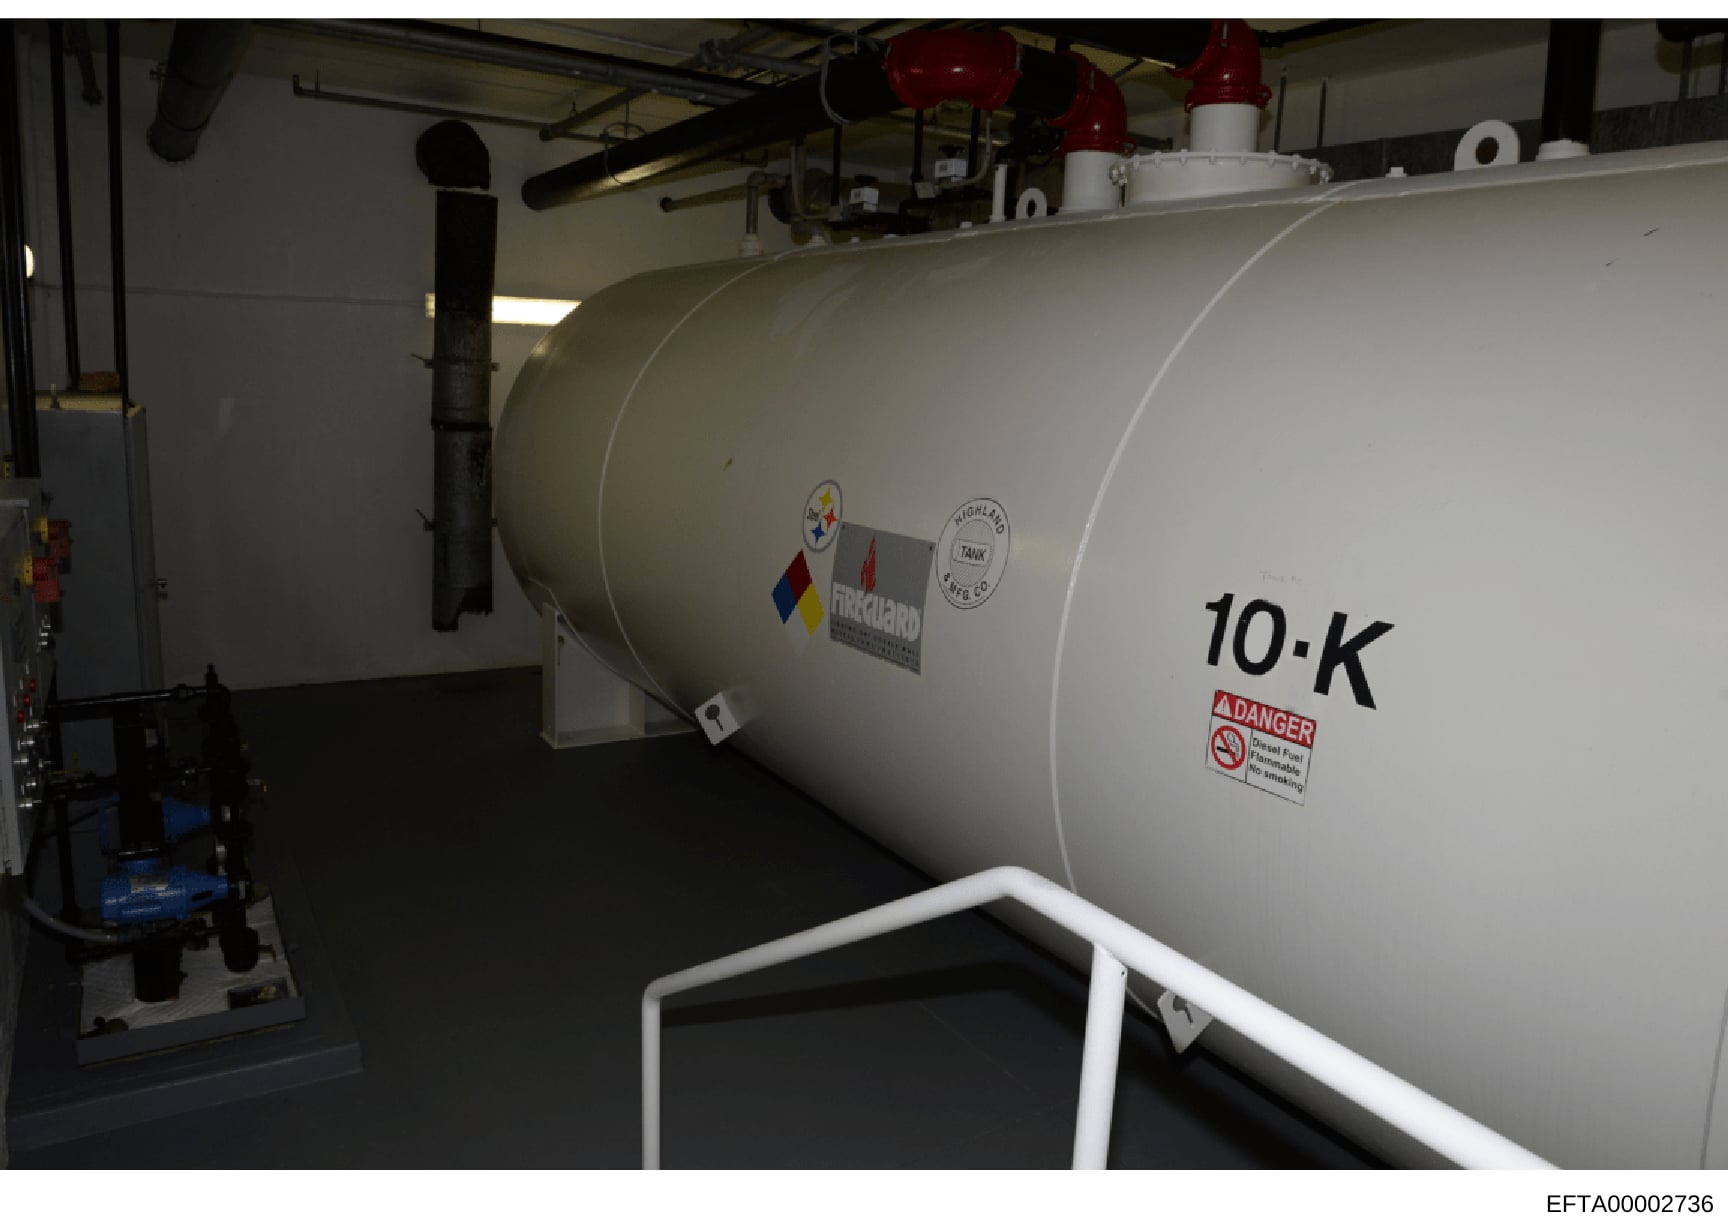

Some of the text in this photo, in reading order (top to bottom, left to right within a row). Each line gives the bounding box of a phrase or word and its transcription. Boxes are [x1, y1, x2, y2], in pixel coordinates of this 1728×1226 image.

[954, 504, 1005, 535] HIGHLAND
[961, 545, 987, 562] TANK
[1234, 698, 1314, 745] DANGER
[1250, 750, 1301, 777] Flammable
[1252, 737, 1304, 763] Diesel Fuel
[1249, 763, 1304, 794] No smoking
